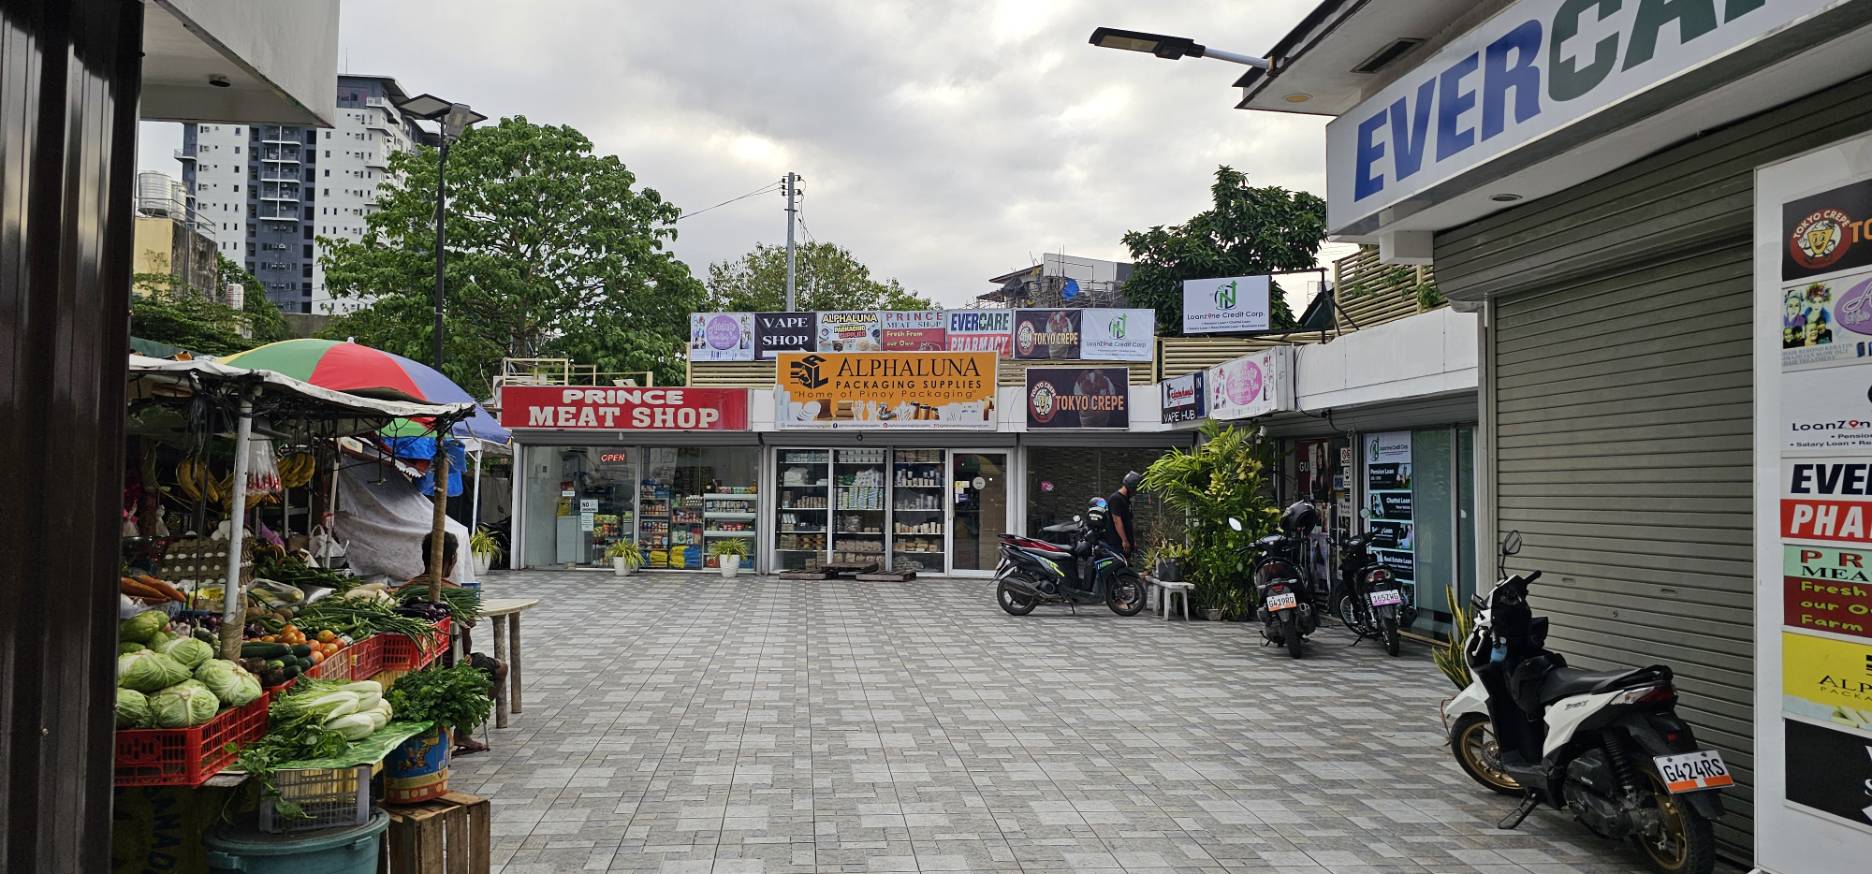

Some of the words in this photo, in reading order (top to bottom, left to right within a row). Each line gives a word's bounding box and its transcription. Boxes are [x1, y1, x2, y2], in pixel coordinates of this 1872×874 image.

[1354, 0, 1766, 202] EVERCA
[1793, 212, 1821, 239] TOKYO
[1824, 209, 1850, 227] CREPE
[763, 317, 809, 328] VAPE
[822, 312, 879, 324] ALPHALUNA
[886, 312, 943, 321] PRINCE
[951, 313, 1010, 330] EVERCARE
[762, 335, 809, 346] SHOP
[951, 336, 1009, 355] PHARMACY
[1034, 332, 1054, 345] TOKYO
[1056, 332, 1078, 344] CREPE
[836, 357, 980, 377] ALPHALUNA
[836, 380, 915, 390] PACKAGING
[923, 380, 981, 389] SUPPLIES
[1031, 382, 1044, 398] TOKYO
[562, 390, 684, 405] PRINCE
[841, 390, 853, 398] of
[860, 390, 894, 400] Pinoy
[1056, 396, 1088, 412] TOKYO
[1092, 396, 1124, 411] CREPE
[529, 406, 621, 427] MEAT
[632, 407, 720, 428] SHOP
[1164, 412, 1180, 423] VAPE
[1182, 410, 1195, 421] HUB
[601, 454, 624, 462] OPEN
[1791, 464, 1872, 496] EVE
[1791, 504, 1872, 539] PHA
[1801, 566, 1872, 582] MEA
[1801, 581, 1868, 597] Fresh
[1800, 601, 1840, 610] our
[1848, 604, 1872, 615] O
[1801, 614, 1864, 632] Farm
[1663, 758, 1725, 782] G424RS
